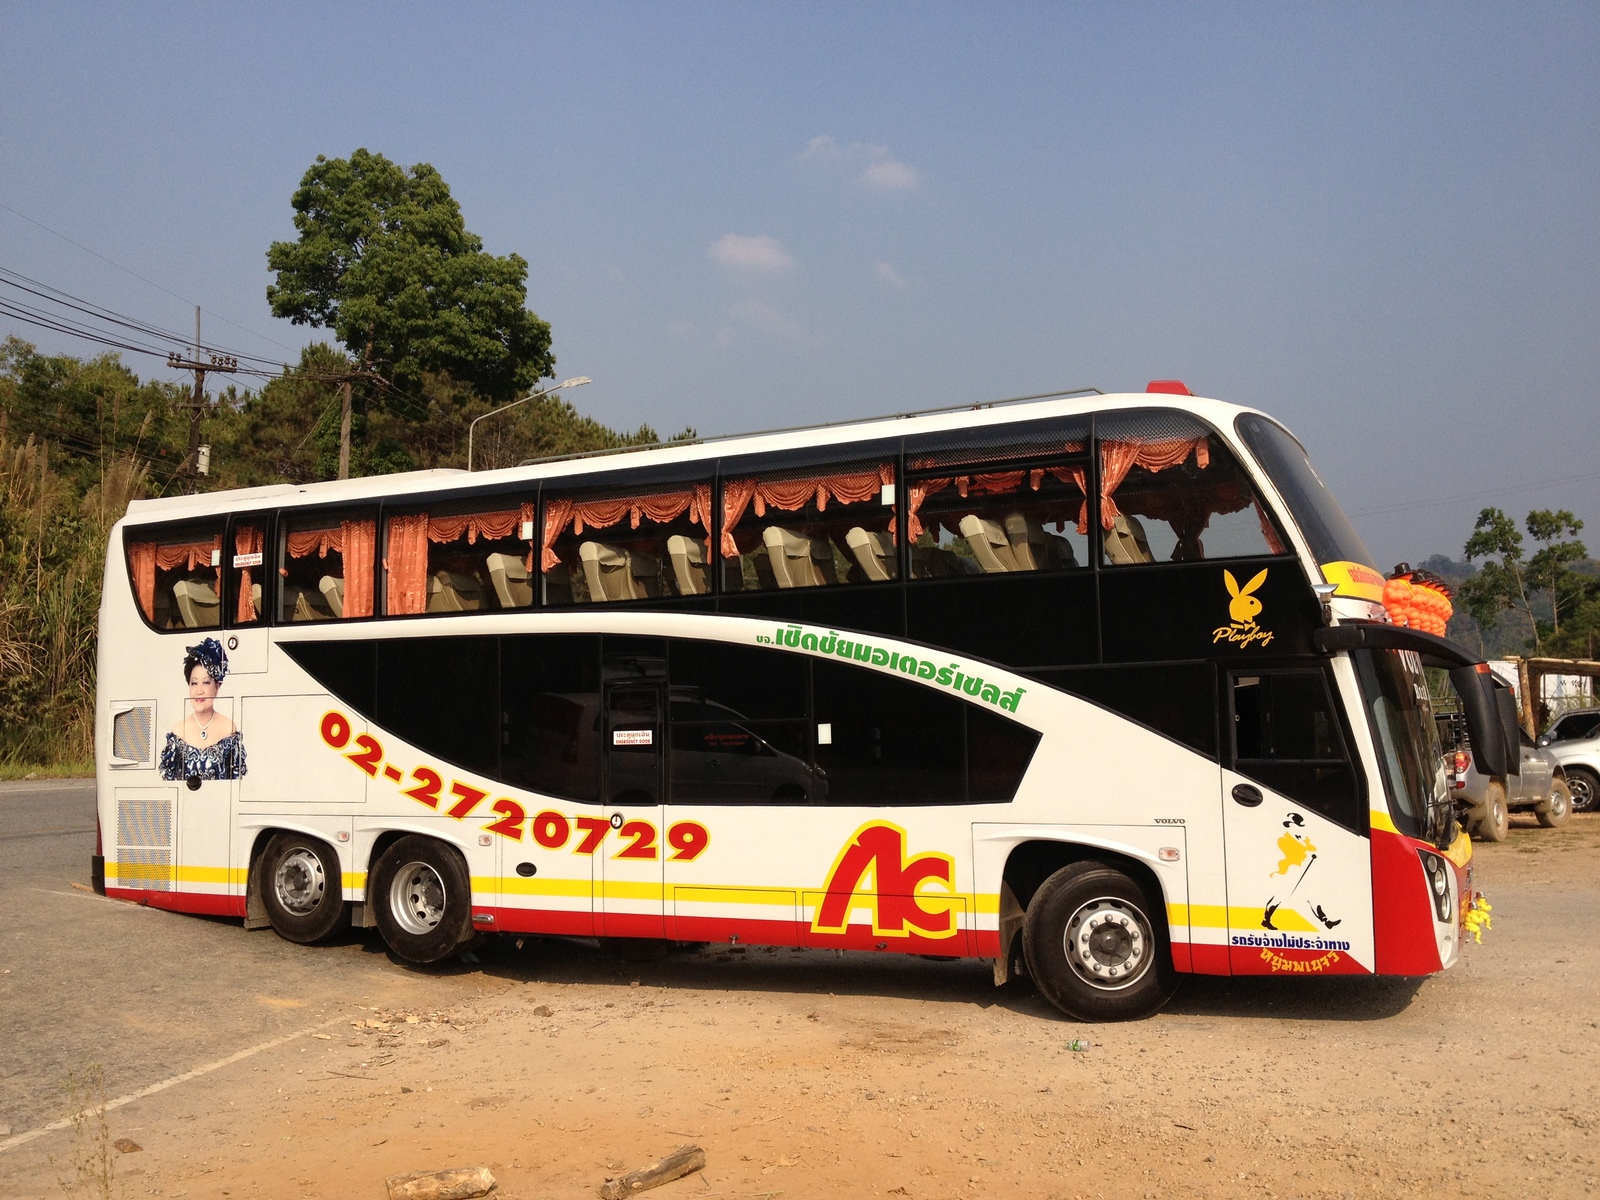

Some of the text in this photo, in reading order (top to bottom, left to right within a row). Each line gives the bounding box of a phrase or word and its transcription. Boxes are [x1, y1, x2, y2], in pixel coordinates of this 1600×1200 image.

[1213, 626, 1274, 649] Playboy
[1231, 933, 1350, 951] รถรับจ้างไม่ประจำทาง
